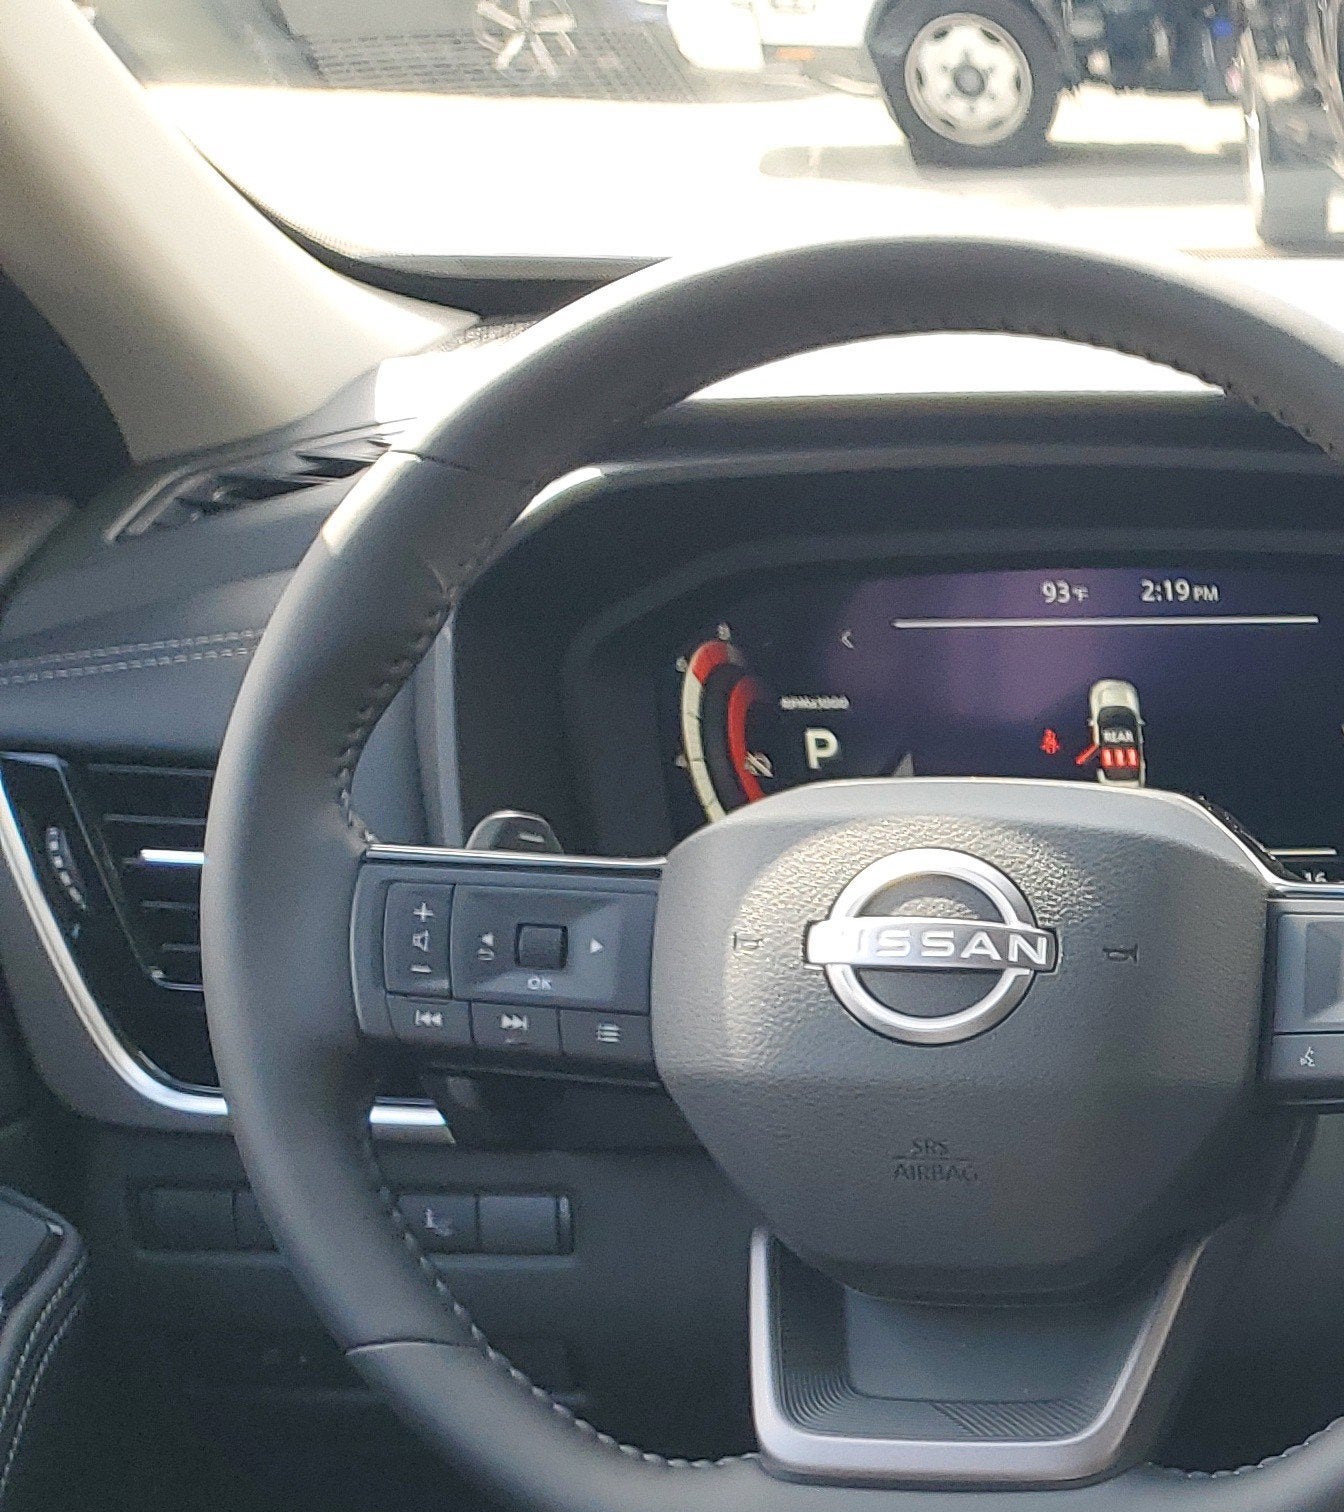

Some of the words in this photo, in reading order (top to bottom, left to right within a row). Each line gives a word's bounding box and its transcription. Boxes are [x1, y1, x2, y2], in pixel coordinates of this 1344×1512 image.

[1042, 579, 1071, 603] 93
[1141, 578, 1190, 602] 2:19
[1192, 585, 1219, 602] PM
[804, 727, 839, 770] P
[814, 925, 1048, 965] ISSAN
[527, 977, 554, 992] OK
